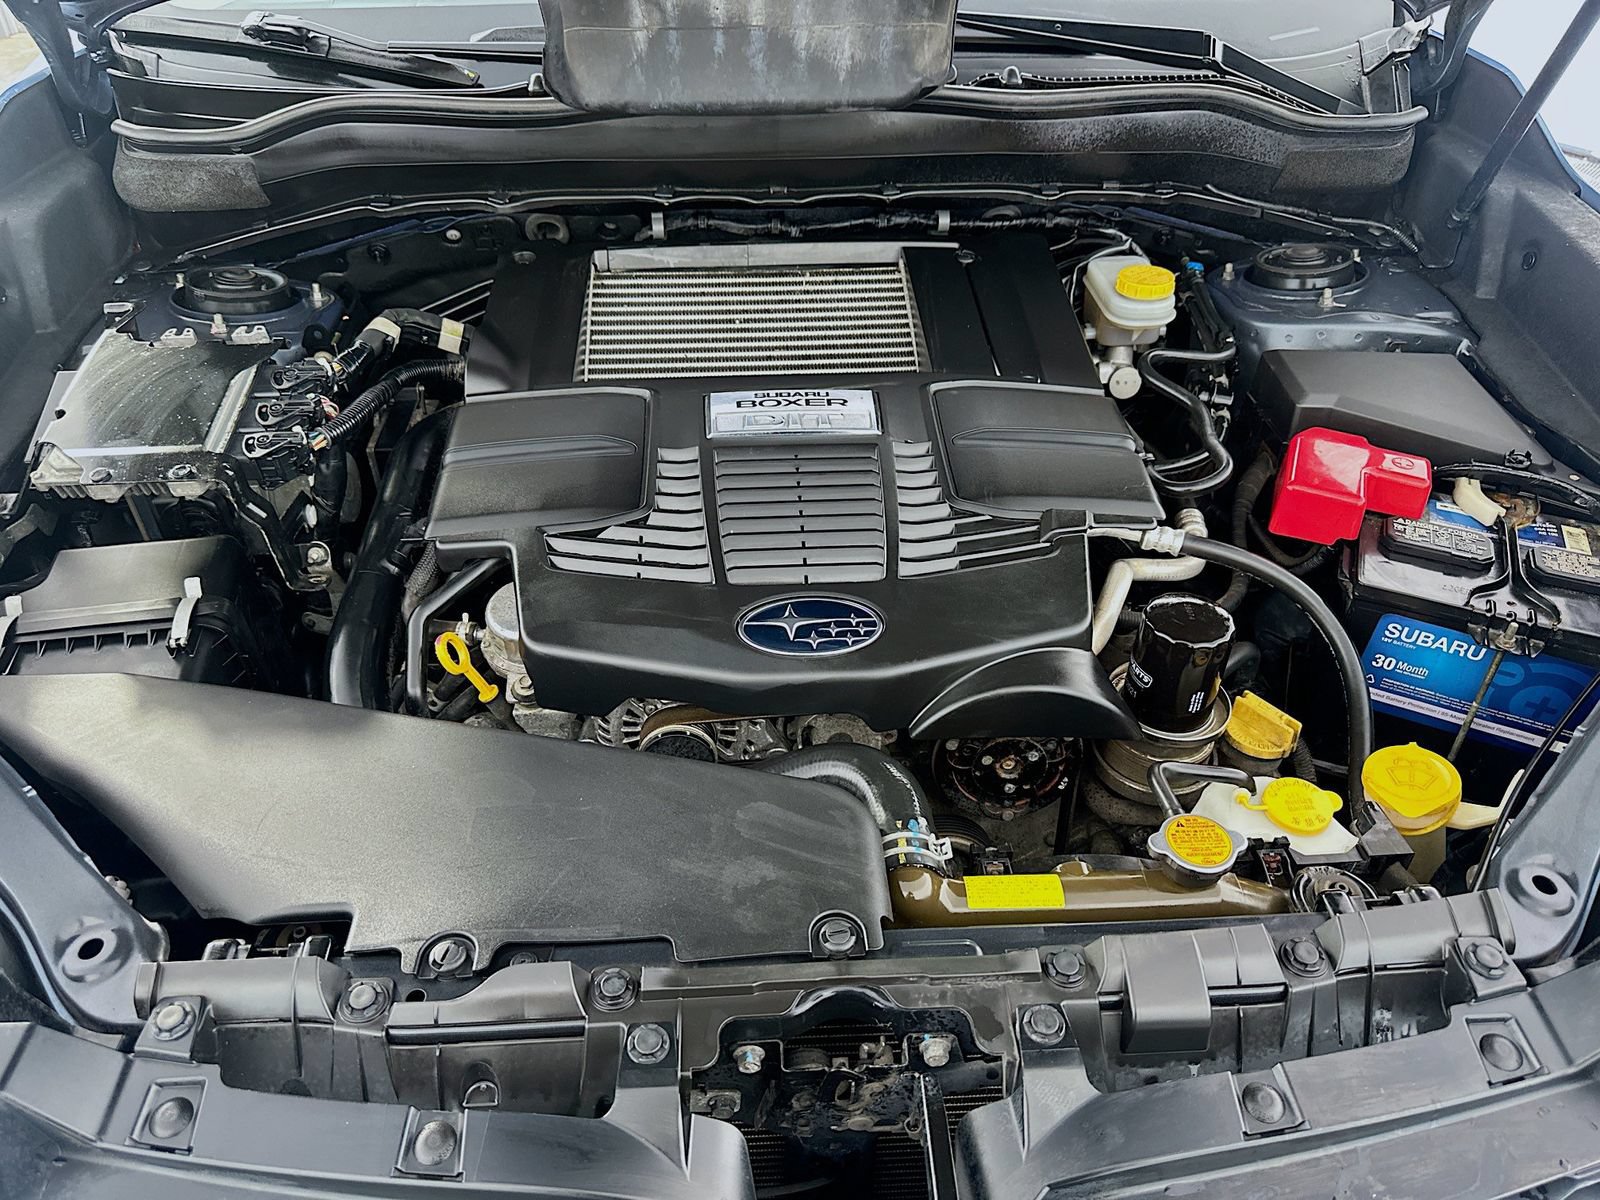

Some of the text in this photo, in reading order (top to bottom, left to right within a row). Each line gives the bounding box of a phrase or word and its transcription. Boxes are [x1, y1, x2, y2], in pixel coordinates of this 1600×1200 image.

[736, 399, 849, 408] BOXER
[744, 412, 844, 430] DIT
[1384, 622, 1487, 661] SUBARU
[1392, 639, 1416, 650] BATTERY
[1371, 653, 1429, 677] 30 Month
